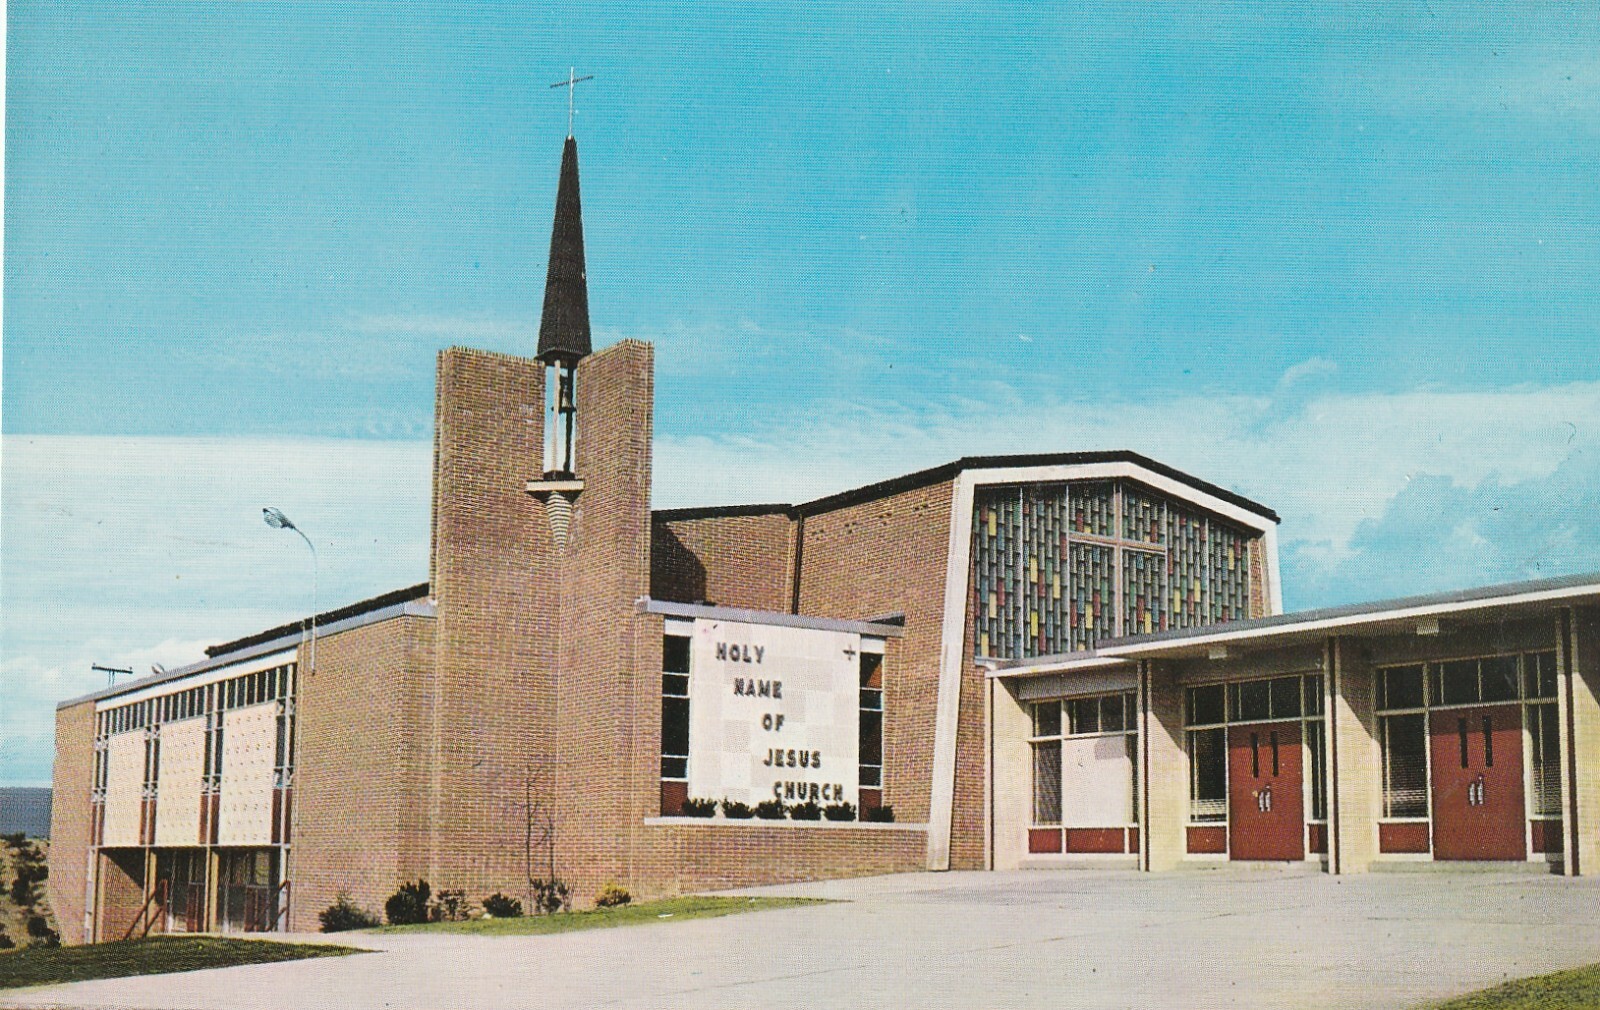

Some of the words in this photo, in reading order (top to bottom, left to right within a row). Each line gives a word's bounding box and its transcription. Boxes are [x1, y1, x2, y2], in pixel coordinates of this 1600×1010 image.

[715, 642, 765, 663] HOLY
[733, 677, 783, 699] NAME
[762, 713, 785, 732] OF
[763, 748, 821, 769] JESUS
[773, 781, 843, 801] CHURCH
